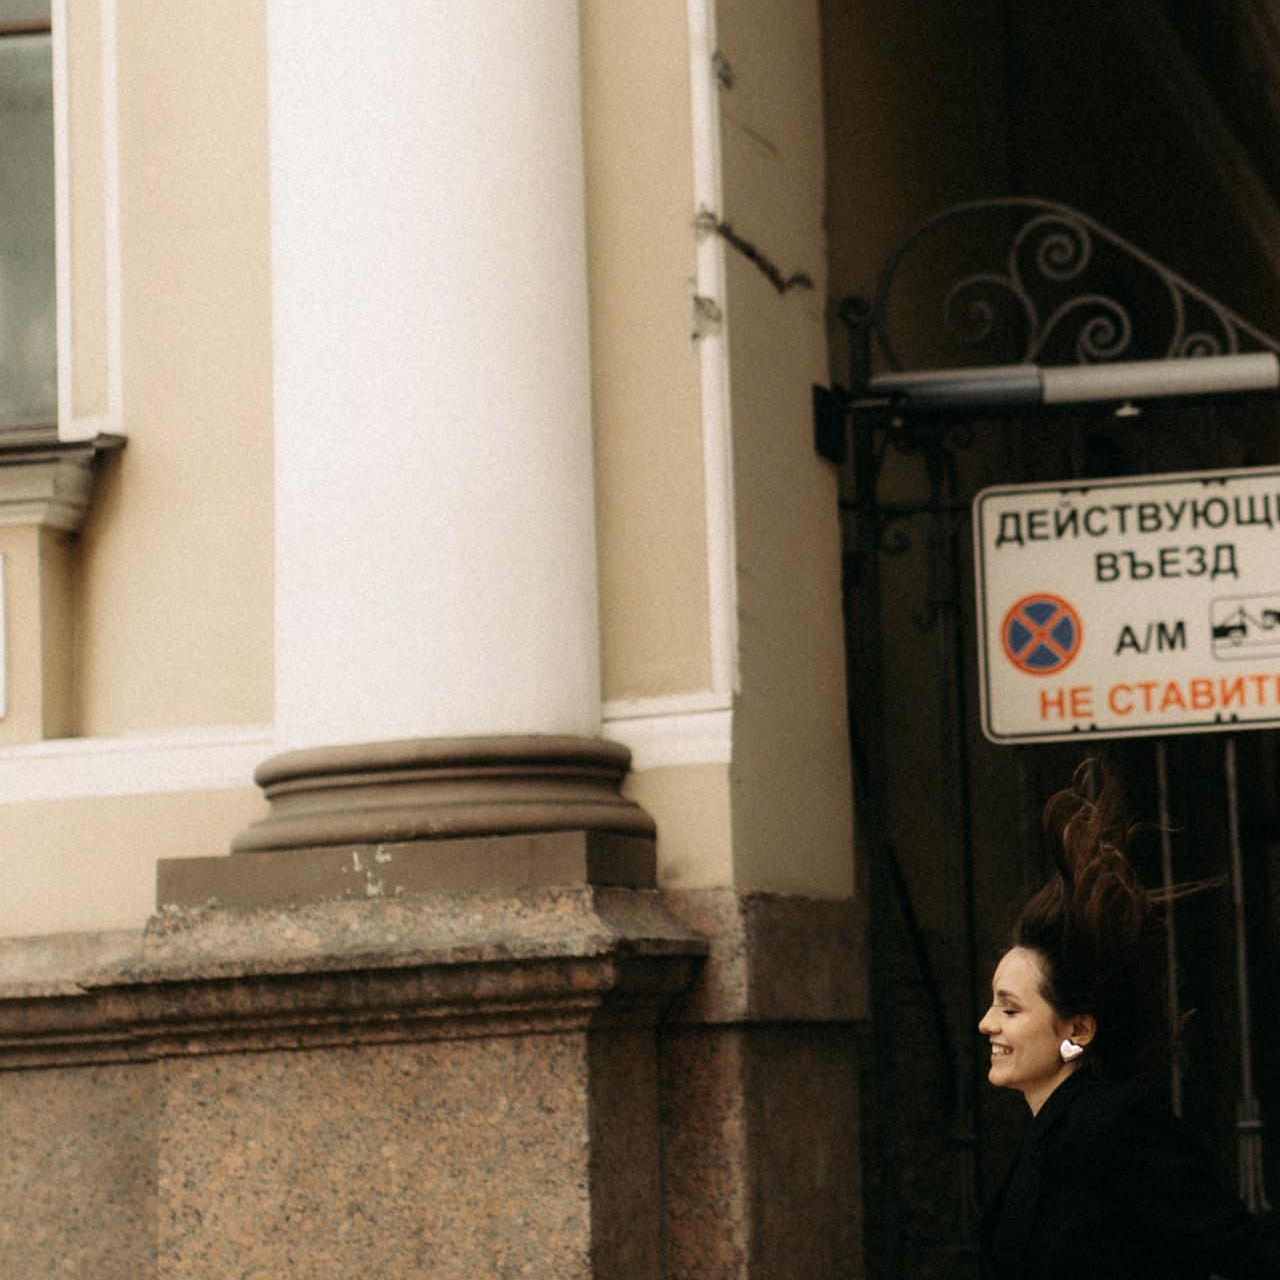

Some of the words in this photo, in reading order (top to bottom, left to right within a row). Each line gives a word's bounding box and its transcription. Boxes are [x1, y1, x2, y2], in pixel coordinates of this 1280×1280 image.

[1095, 544, 1239, 582] ВЪЕЗД
[1115, 621, 1187, 655] А/М
[1040, 685, 1093, 720] НЕ
